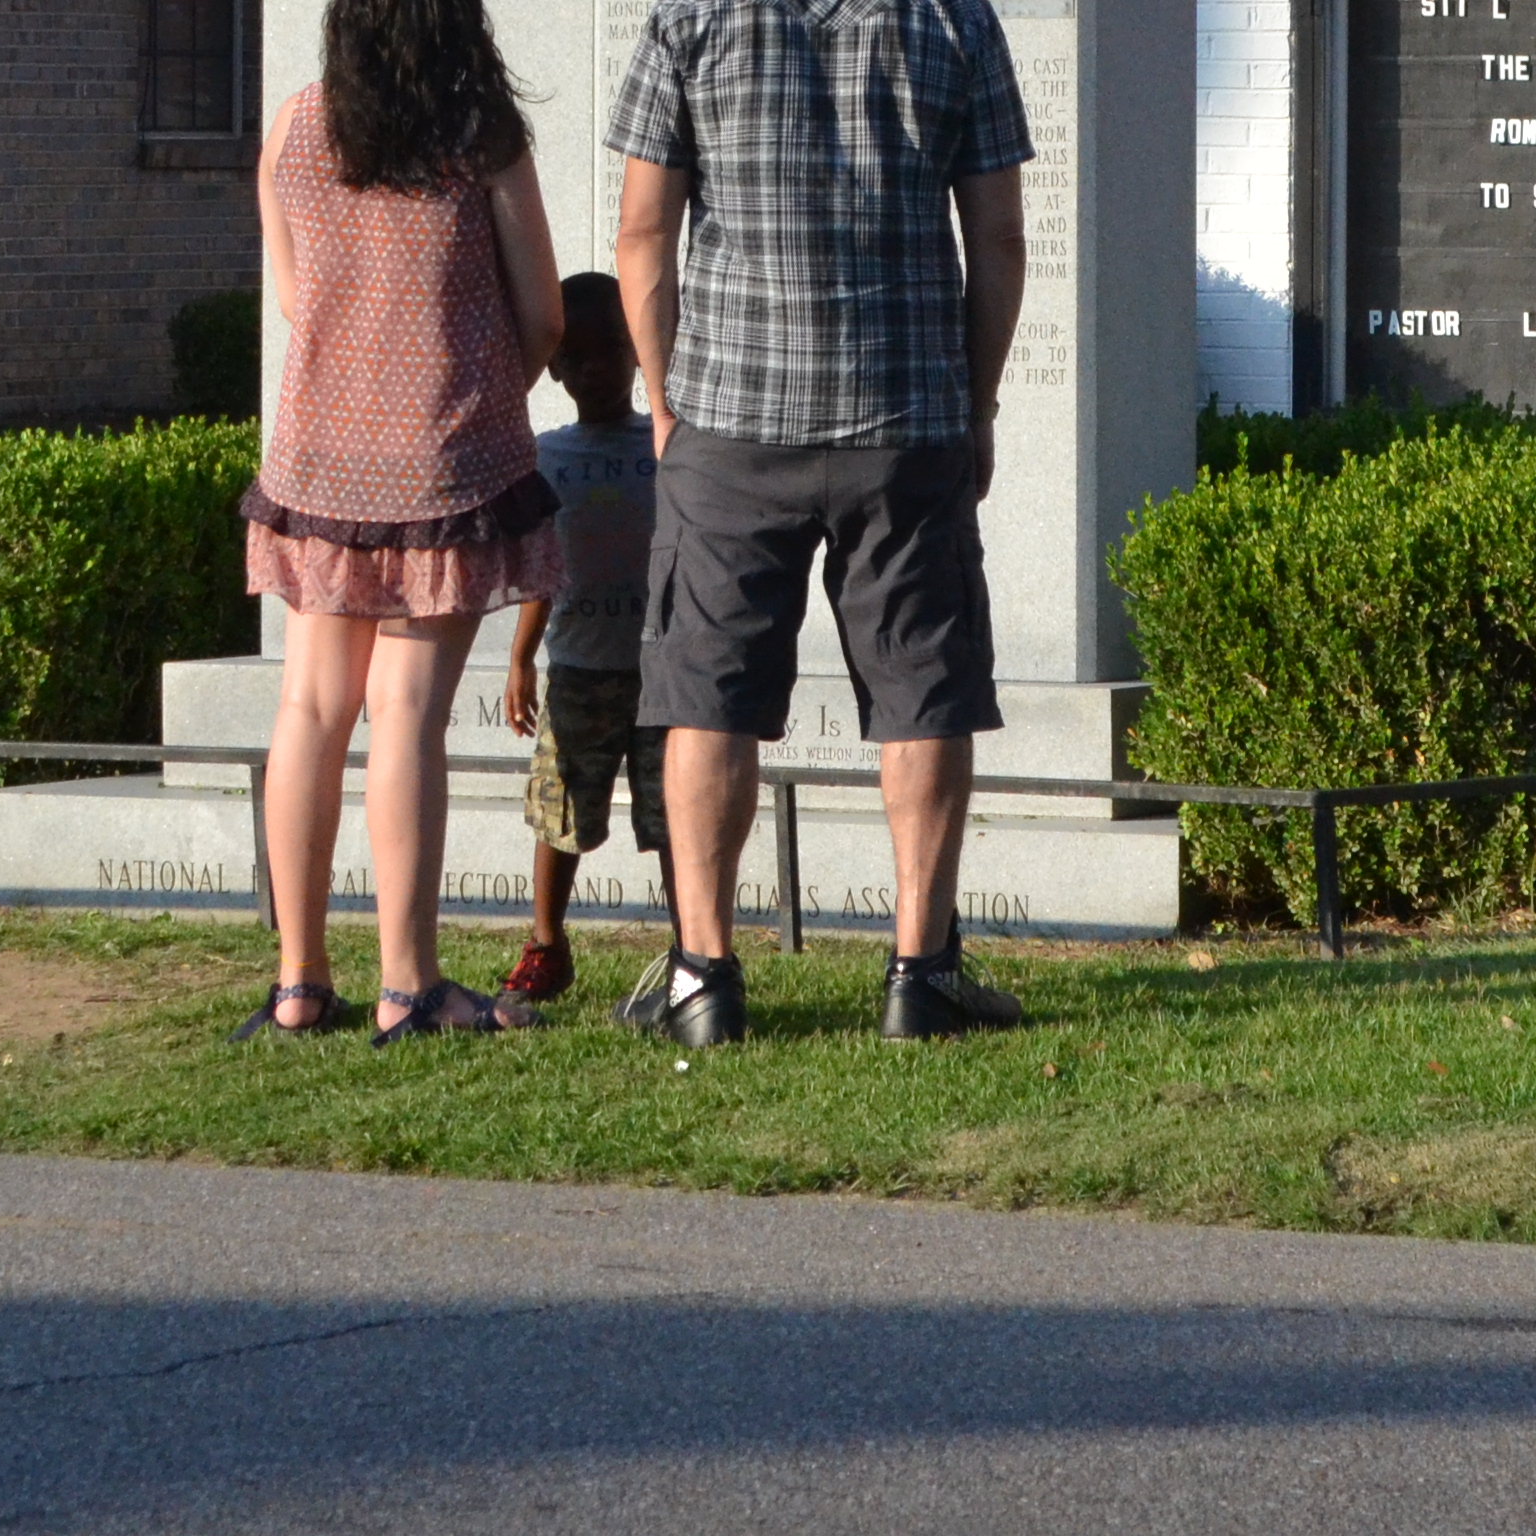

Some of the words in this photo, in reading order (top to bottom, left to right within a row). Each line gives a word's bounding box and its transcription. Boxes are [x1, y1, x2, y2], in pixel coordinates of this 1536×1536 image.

[1034, 58, 1068, 75] CAST
[1481, 55, 1530, 81] THE
[1041, 81, 1068, 97] THE
[1480, 182, 1510, 209] TO
[1036, 217, 1067, 233] AND
[1369, 310, 1460, 336] PASTOR
[1048, 346, 1067, 362] TO
[1026, 368, 1066, 385] FIRST
[556, 457, 656, 484] KING
[818, 704, 841, 738] Is
[763, 746, 798, 761] JAMES
[806, 747, 852, 762] WELDON
[99, 858, 230, 895] NATIONAL
